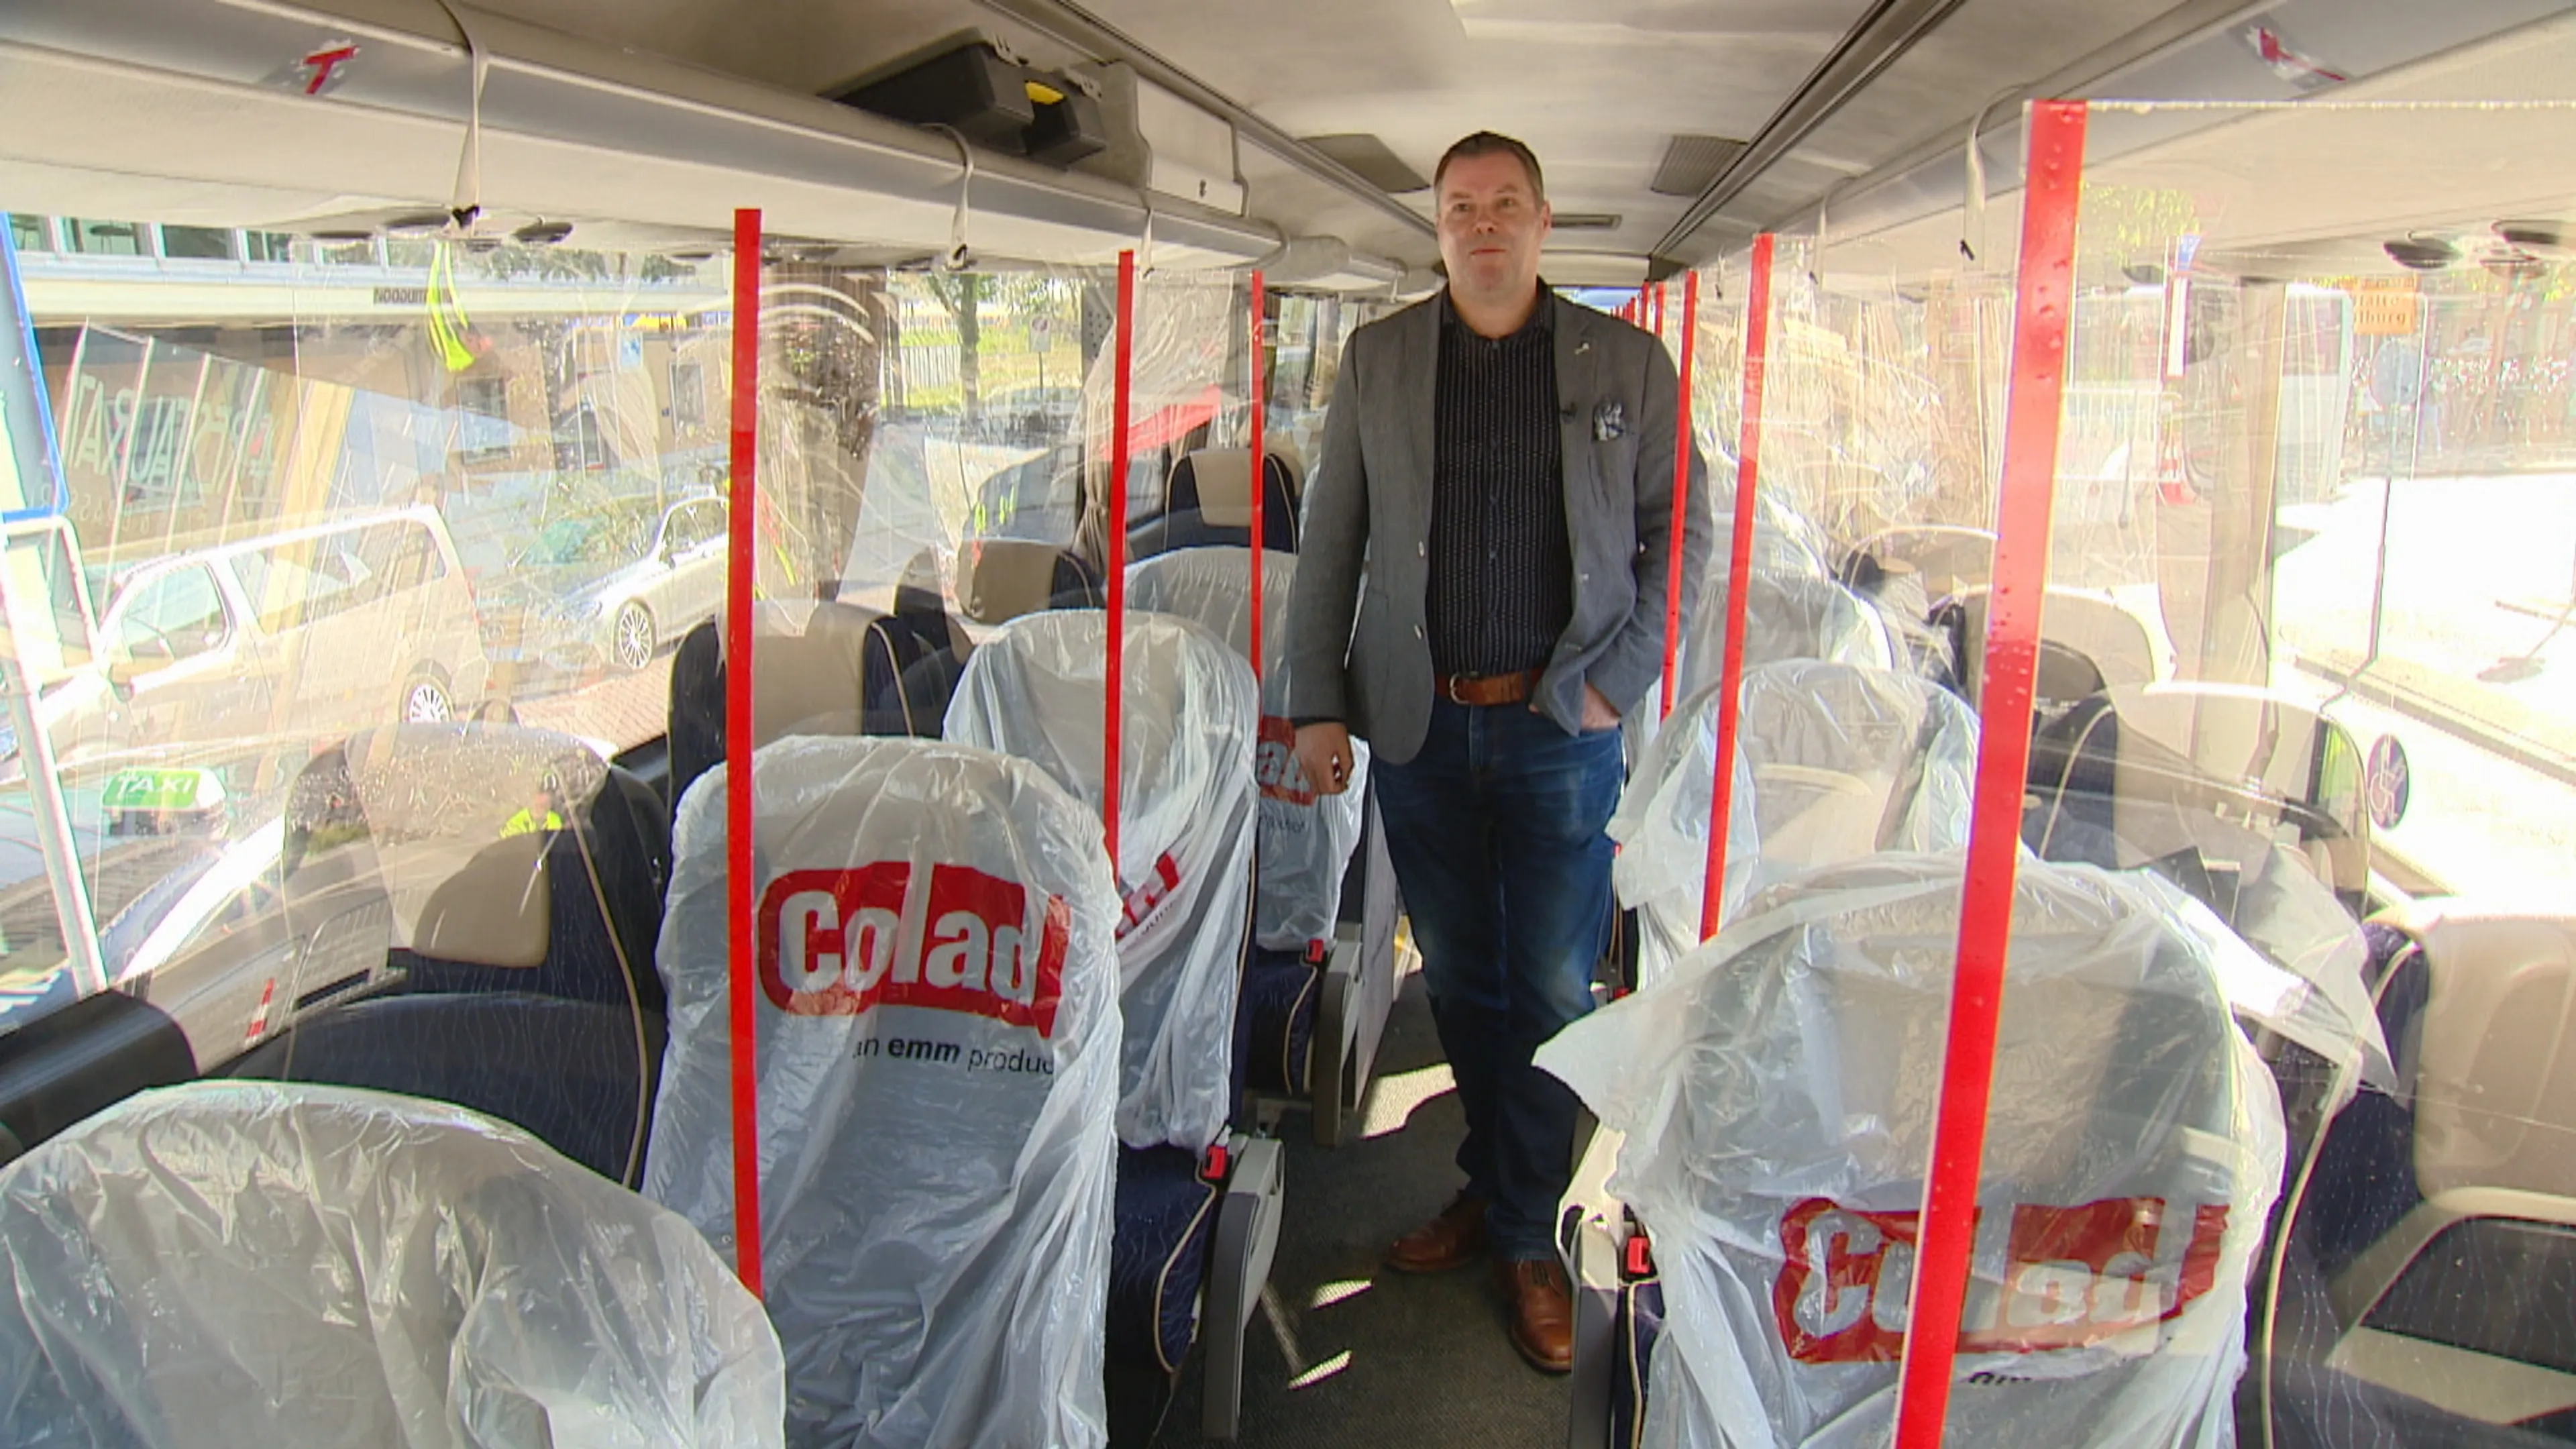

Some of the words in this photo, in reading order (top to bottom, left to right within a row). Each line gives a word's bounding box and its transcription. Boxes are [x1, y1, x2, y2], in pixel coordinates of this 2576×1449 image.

[117, 774, 194, 800] TAXI
[778, 861, 1044, 1006] Colad
[888, 1038, 961, 1064] emm
[968, 1047, 1054, 1075] produc
